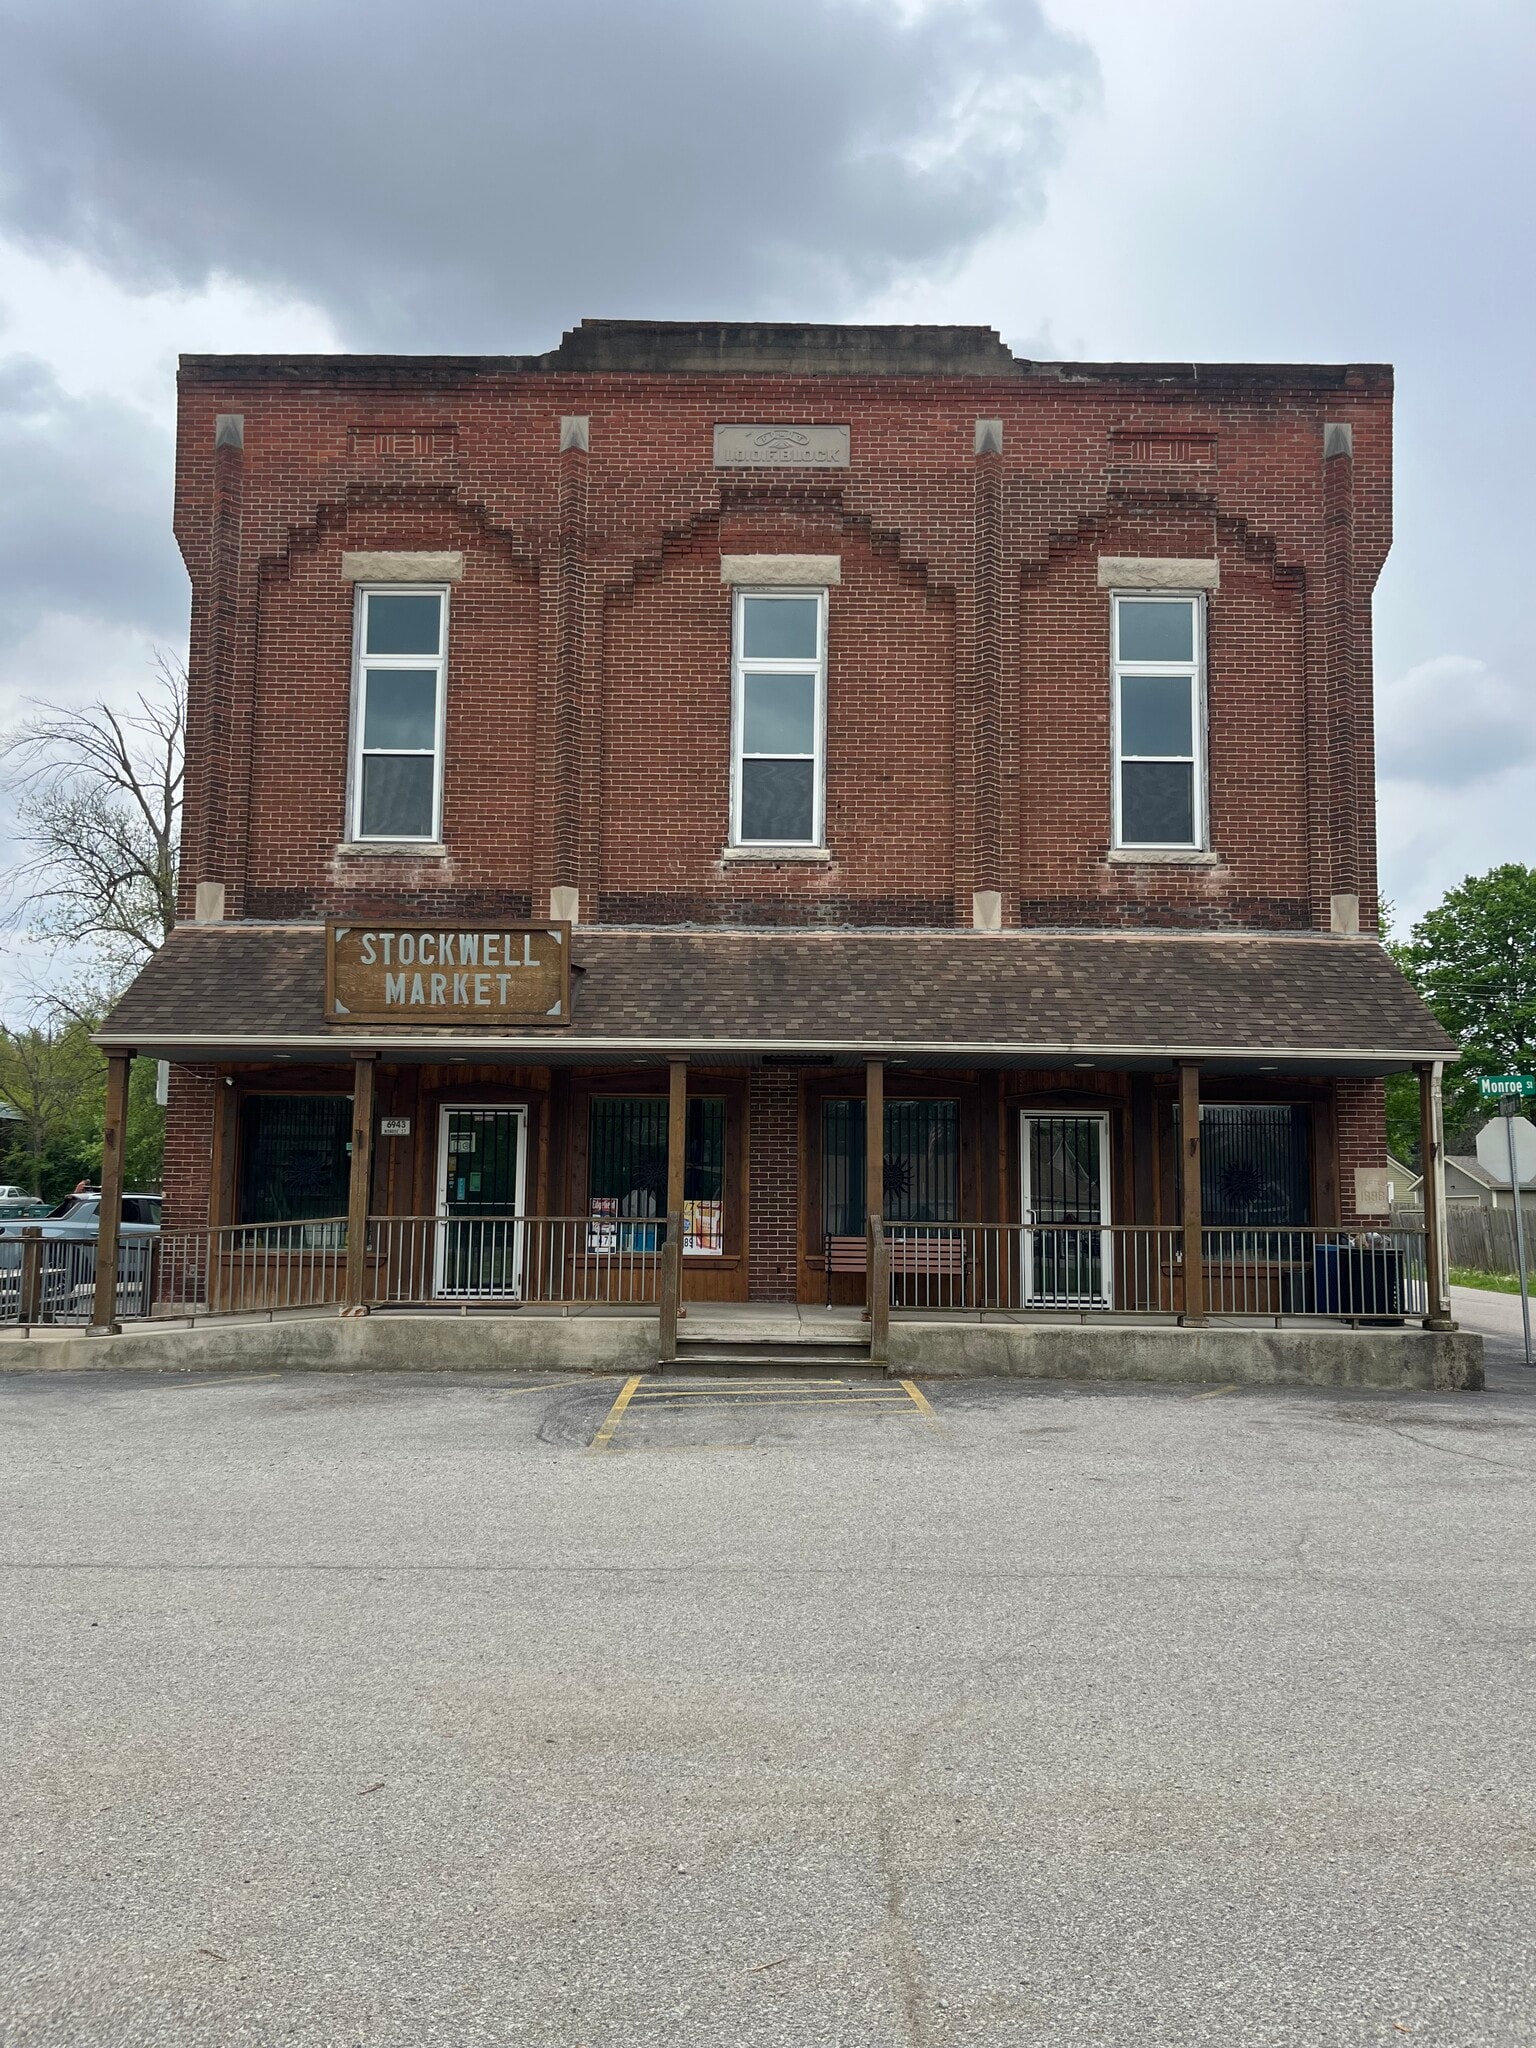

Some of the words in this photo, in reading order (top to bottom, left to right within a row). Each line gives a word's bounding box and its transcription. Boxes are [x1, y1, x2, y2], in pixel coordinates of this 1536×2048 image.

[779, 447, 840, 463] BLOCK
[360, 932, 540, 966] STOCKWELL
[385, 972, 512, 1005] MARKET
[1481, 1079, 1523, 1093] Monroe
[386, 1120, 406, 1129] 6943
